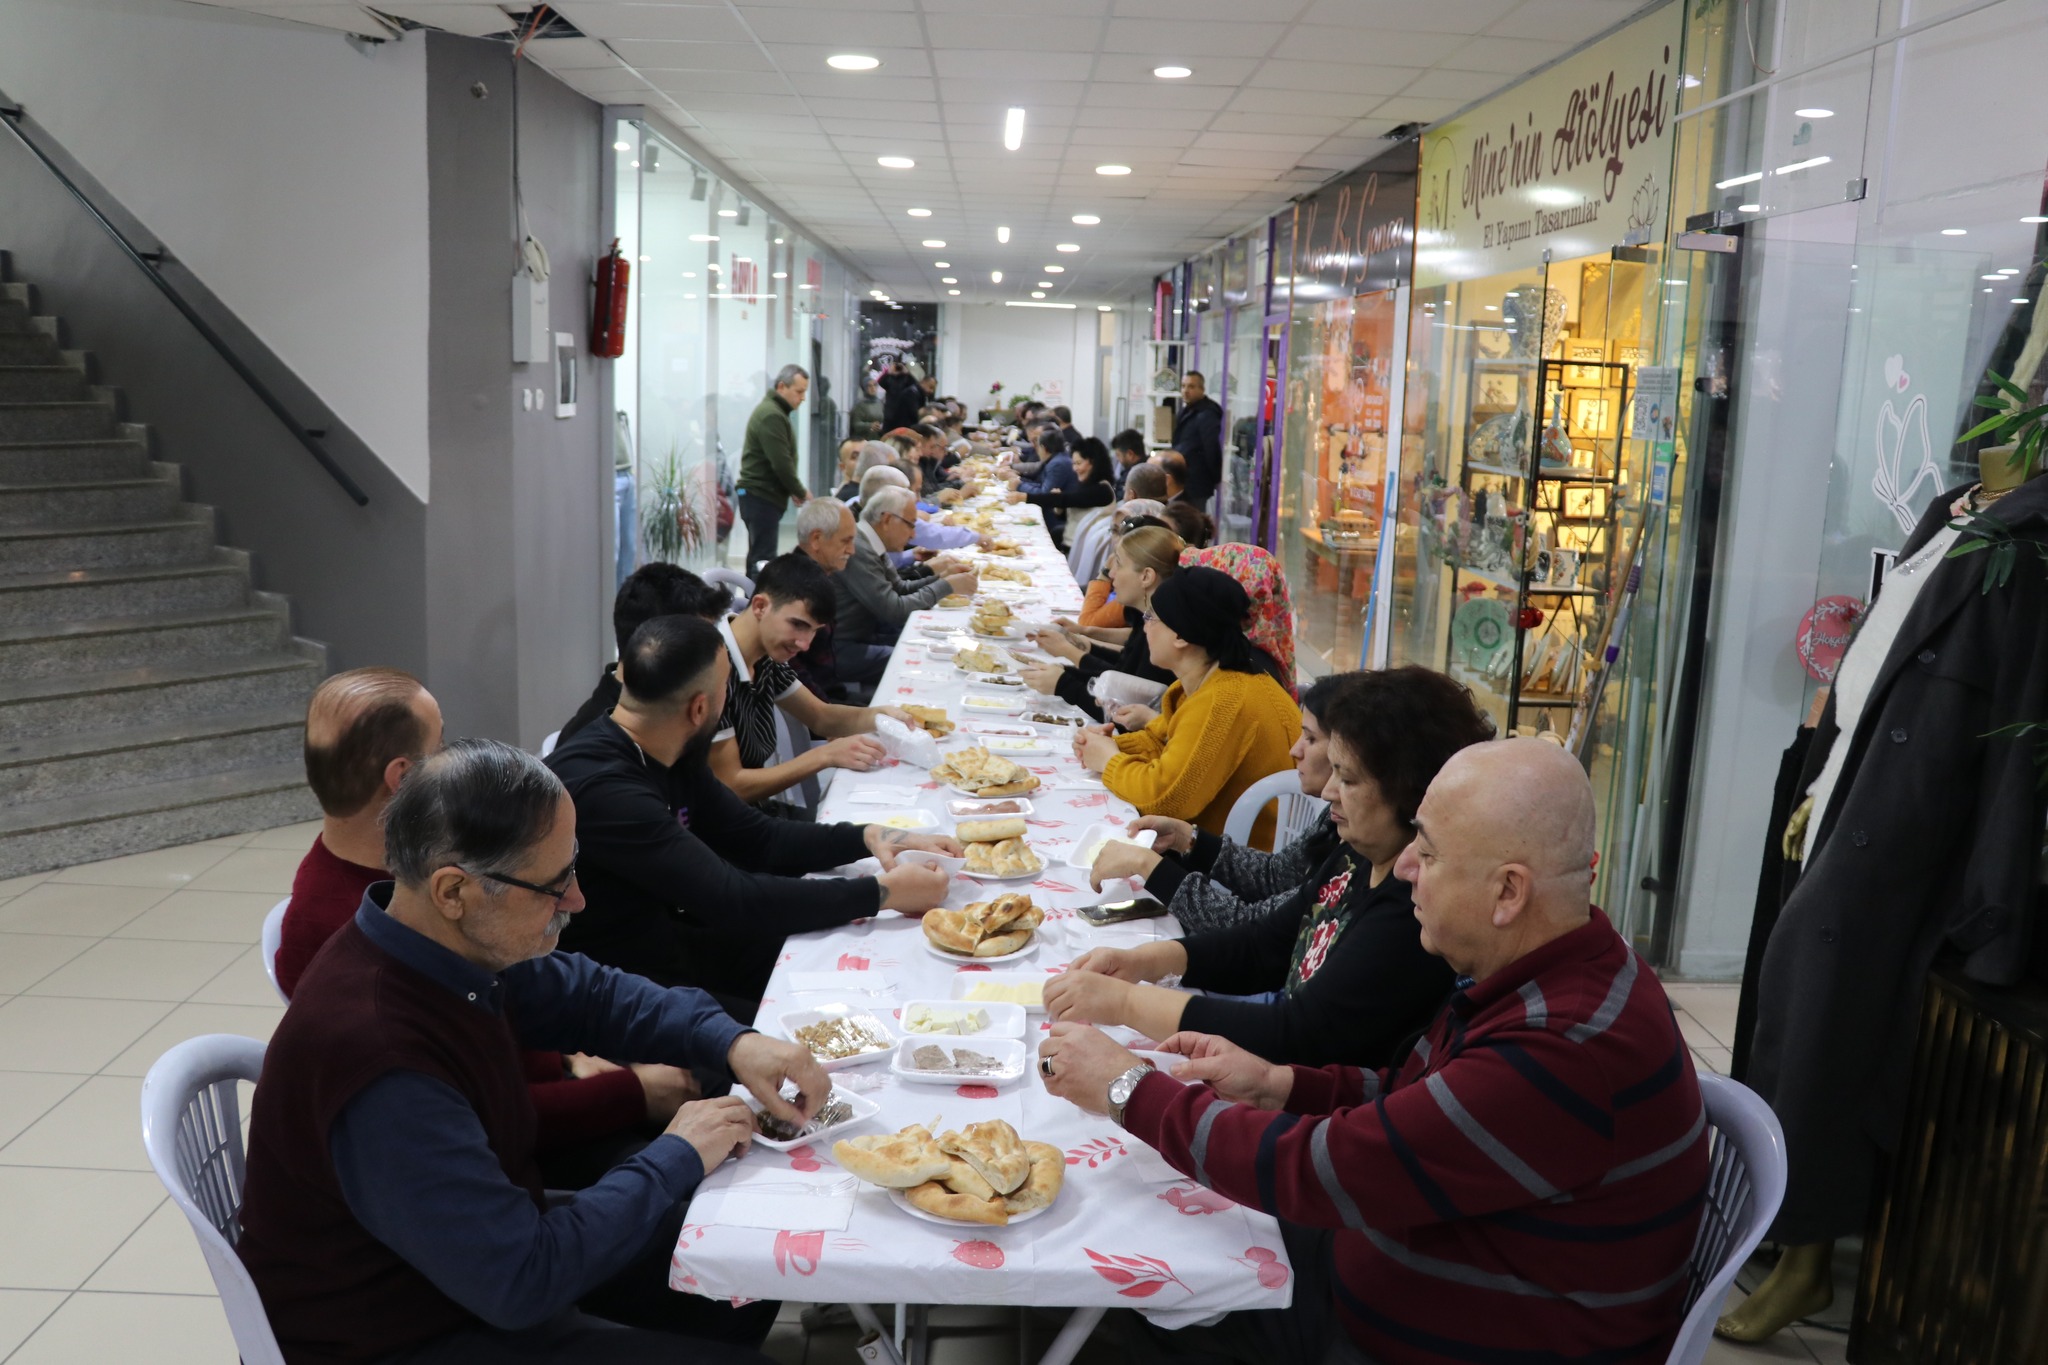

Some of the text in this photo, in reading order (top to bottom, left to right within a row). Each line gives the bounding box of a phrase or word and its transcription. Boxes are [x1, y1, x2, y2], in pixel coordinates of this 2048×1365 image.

[1462, 45, 1670, 219] Mine'nin Atölyesi
[1354, 171, 1404, 285] Gonca
[1484, 197, 1600, 250] El Yapımı Tasarımlar
